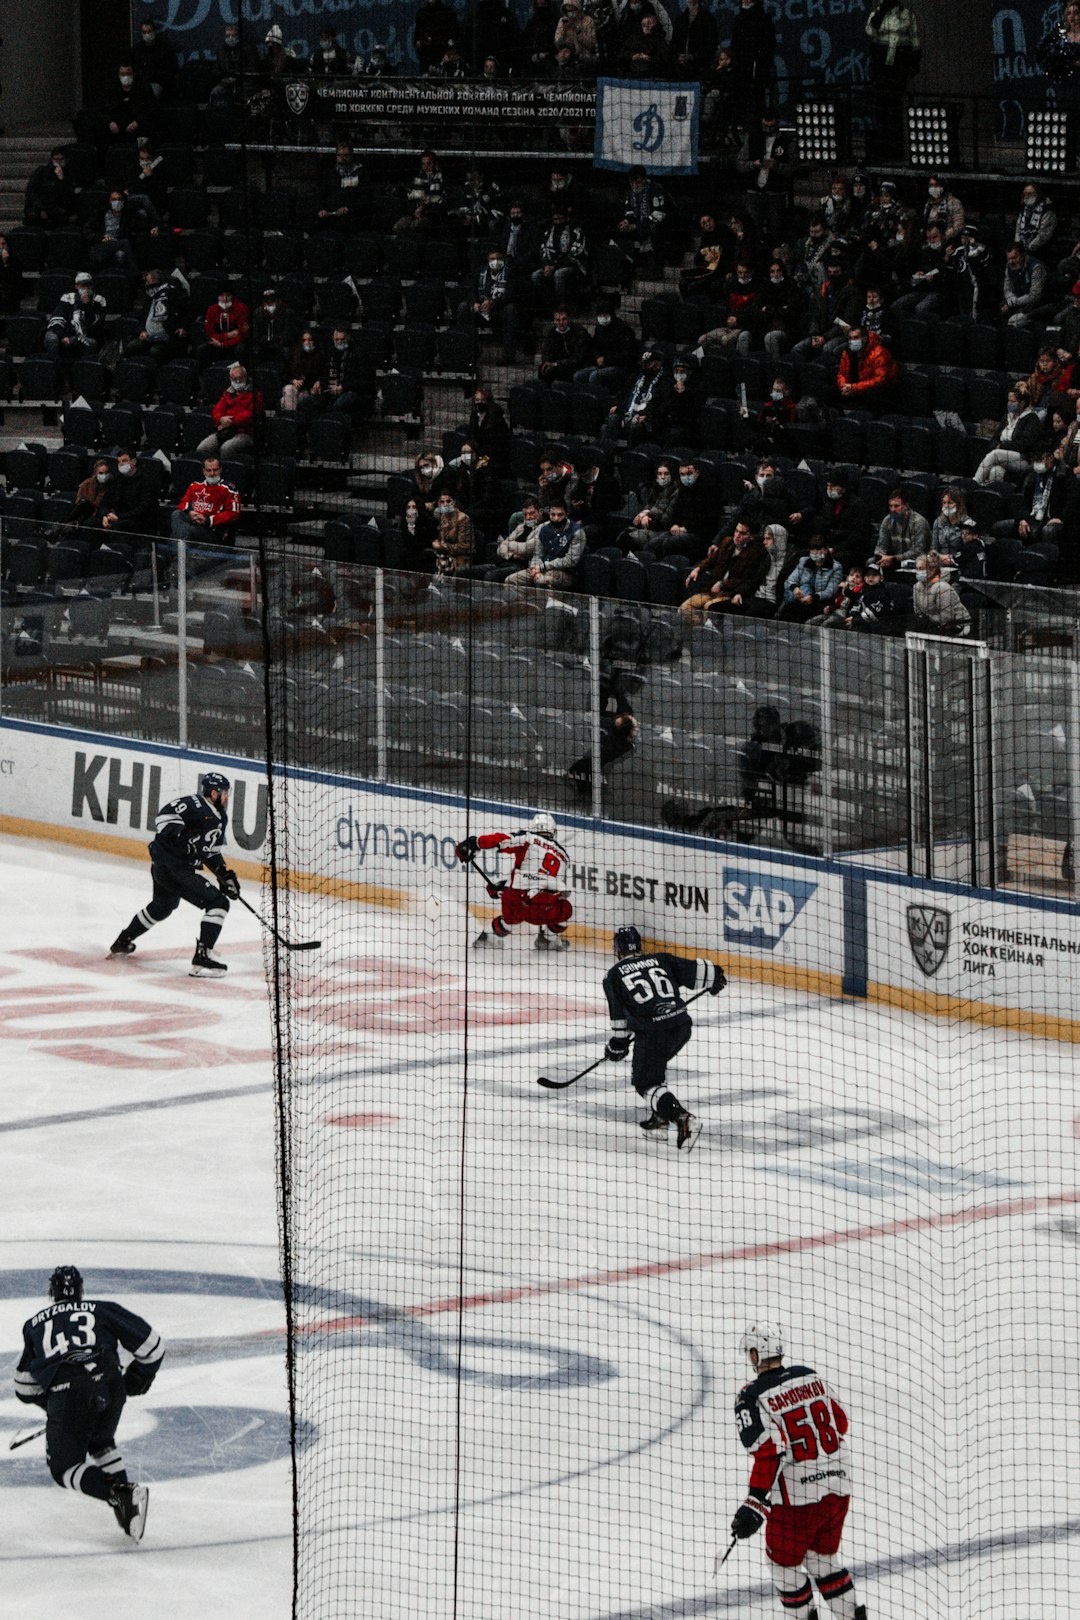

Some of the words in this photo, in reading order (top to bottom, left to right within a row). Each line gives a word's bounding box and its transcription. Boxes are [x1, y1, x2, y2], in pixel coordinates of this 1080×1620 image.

[317, 88, 368, 99] ЧЕМПИОНАТ
[370, 89, 454, 101] КОНТИНЕНТАЛЬНОЙ
[511, 91, 534, 102] ЛИГИ
[543, 93, 597, 103] ЧЕМПИОНАТ
[335, 103, 348, 113] ПО
[348, 103, 384, 114] ХОККЕЮ
[387, 104, 414, 115] СРЕДИ
[416, 104, 461, 116] МУЖСКИХ
[462, 105, 500, 118] КОМАНД
[501, 106, 536, 118] СЕЗОНА
[537, 106, 584, 118] 2020/2021
[606, 869, 659, 904] BEST
[665, 881, 709, 914] RUN
[723, 879, 796, 937] SAP
[962, 939, 1044, 968] ХОККЕЙНАЯ
[962, 959, 997, 978] ЛИГА
[621, 967, 676, 1005] 56
[31, 1302, 97, 1328] BRYZGALOV
[42, 1311, 97, 1359] 43
[782, 1400, 840, 1462] 58
